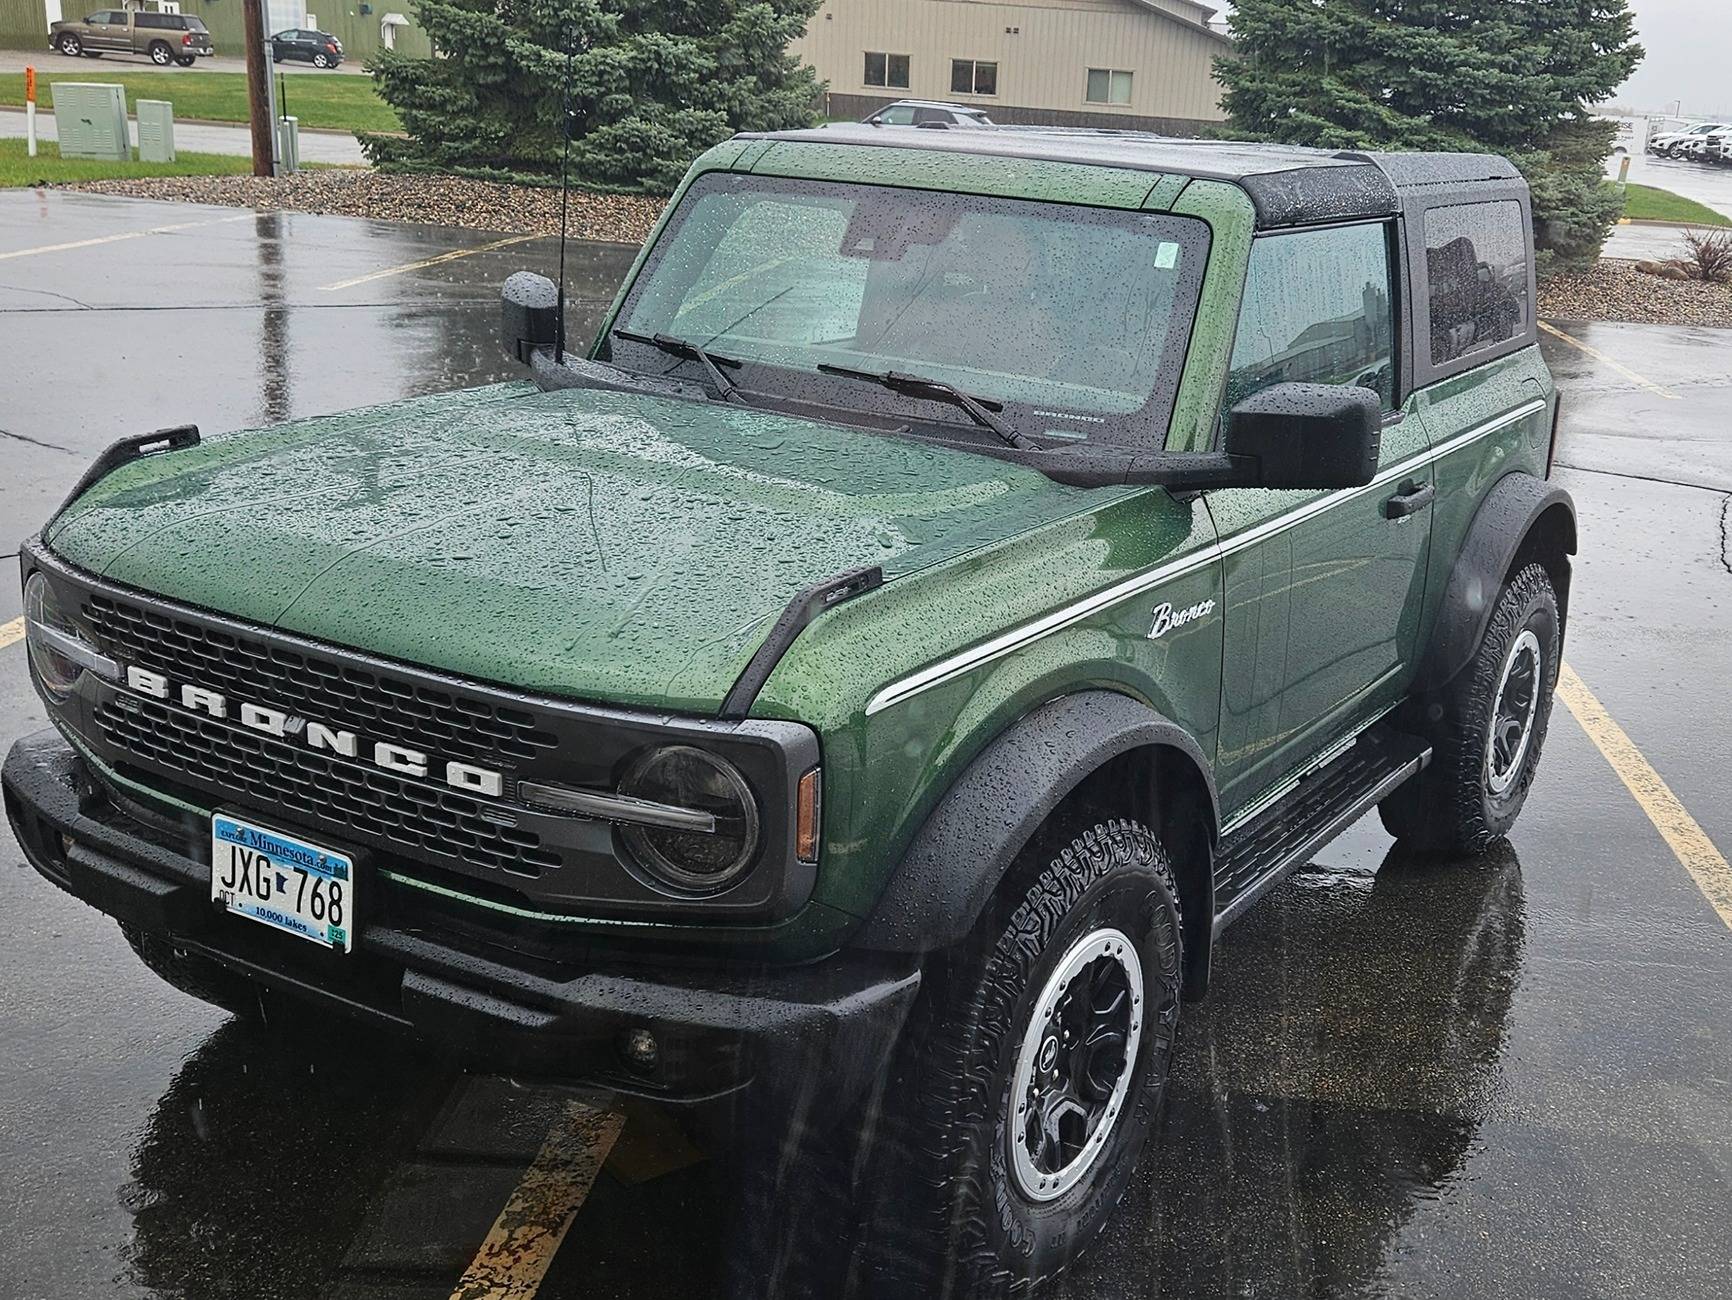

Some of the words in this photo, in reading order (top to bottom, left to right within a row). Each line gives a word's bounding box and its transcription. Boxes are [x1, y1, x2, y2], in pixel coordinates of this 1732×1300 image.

[1144, 599, 1216, 640] Bronco
[127, 665, 503, 797] BRONCO
[221, 846, 271, 901] JXG
[293, 866, 343, 927] 768
[256, 906, 283, 923] 10,000
[285, 916, 307, 932] lakes
